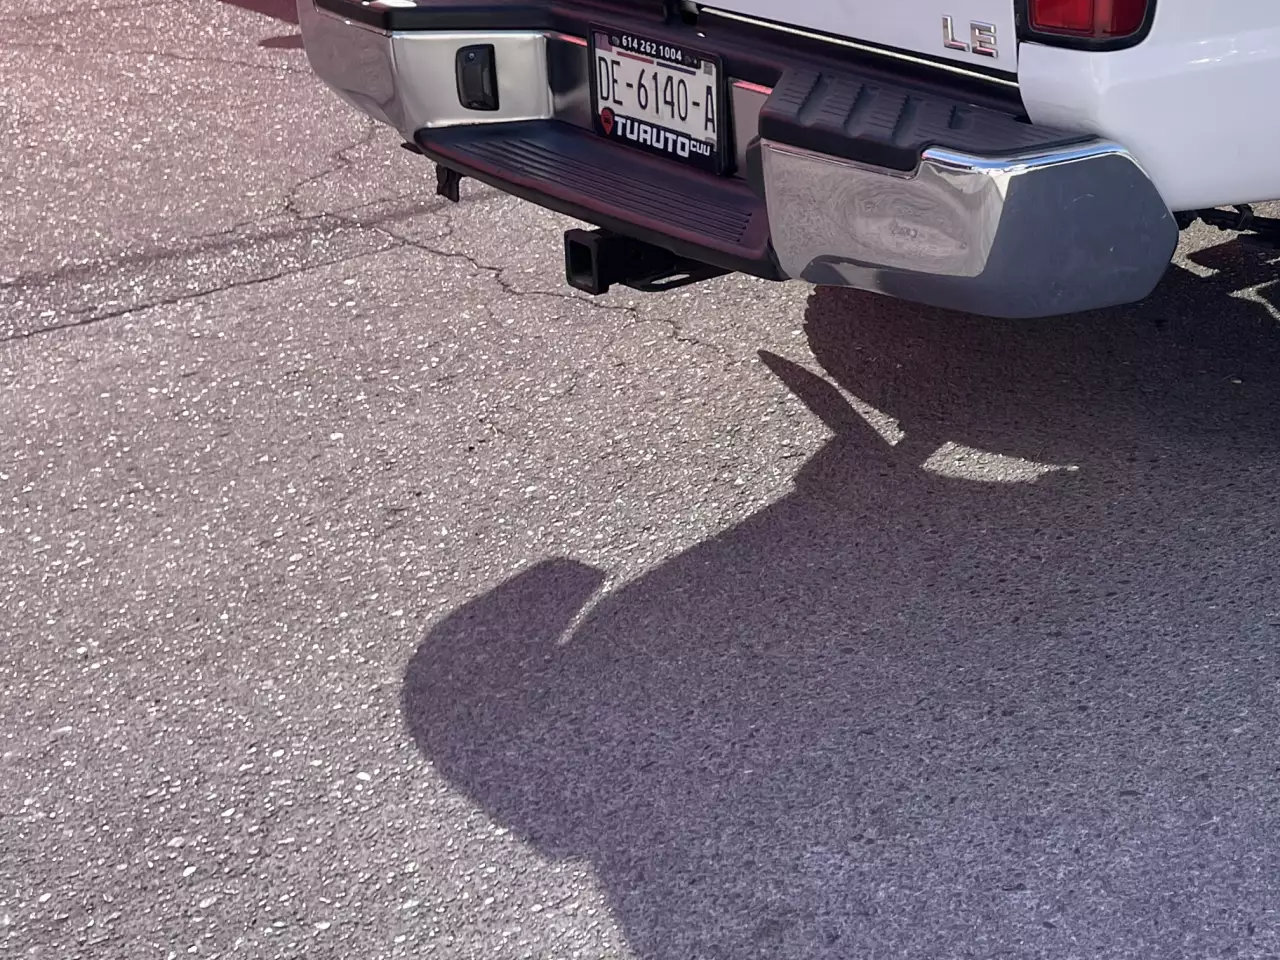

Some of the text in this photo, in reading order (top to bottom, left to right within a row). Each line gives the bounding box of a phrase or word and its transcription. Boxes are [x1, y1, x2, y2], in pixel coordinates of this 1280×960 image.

[621, 35, 682, 61] 614 262 1004
[942, 14, 999, 59] LE
[598, 56, 716, 134] DE-6140-A
